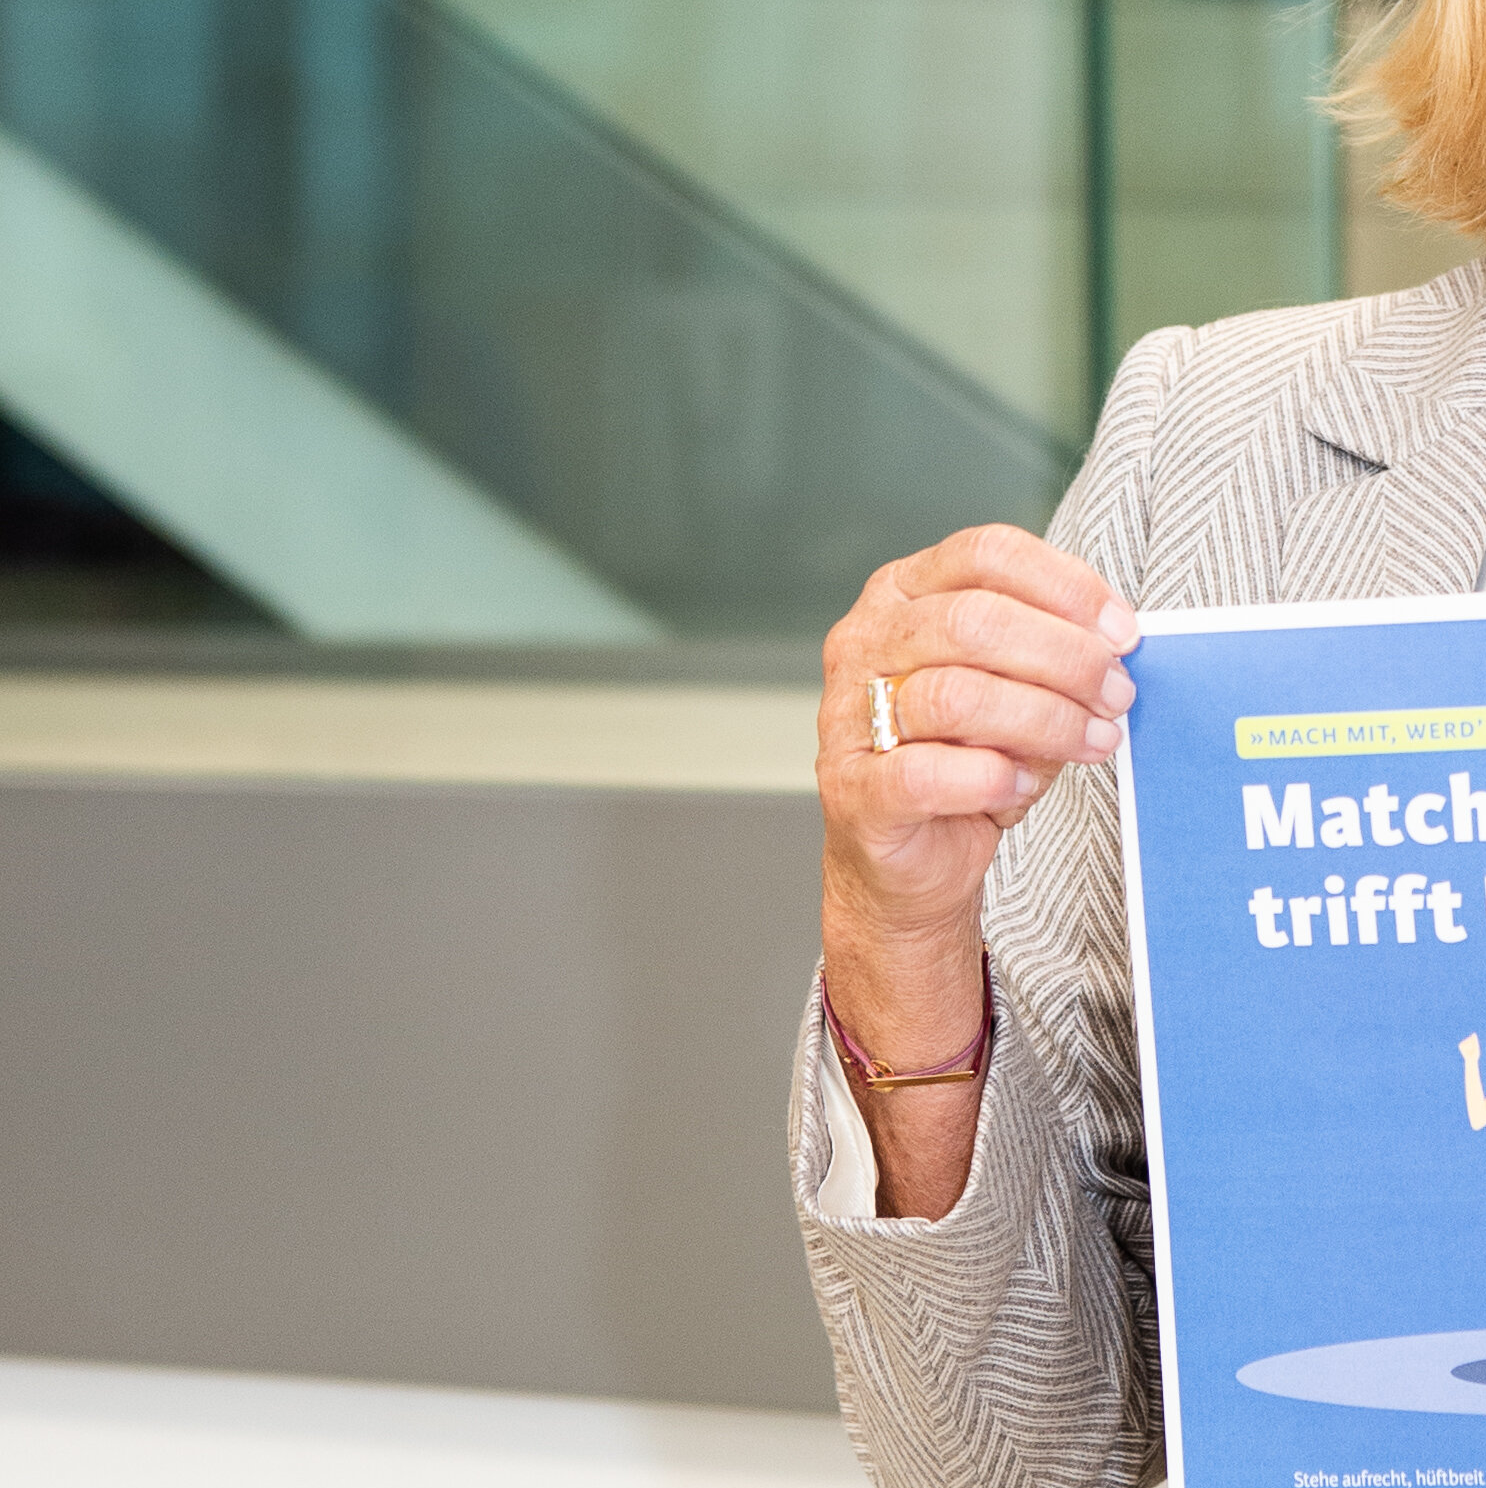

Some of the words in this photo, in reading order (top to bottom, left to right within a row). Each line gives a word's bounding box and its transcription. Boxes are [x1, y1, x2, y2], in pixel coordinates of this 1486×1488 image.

[1347, 724, 1397, 745] MIT,
[1248, 873, 1468, 949] trifft
[1293, 1469, 1339, 1488] Stehe
[1341, 1469, 1412, 1488] aufrecht,
[1415, 1468, 1486, 1487] hüftbreit
